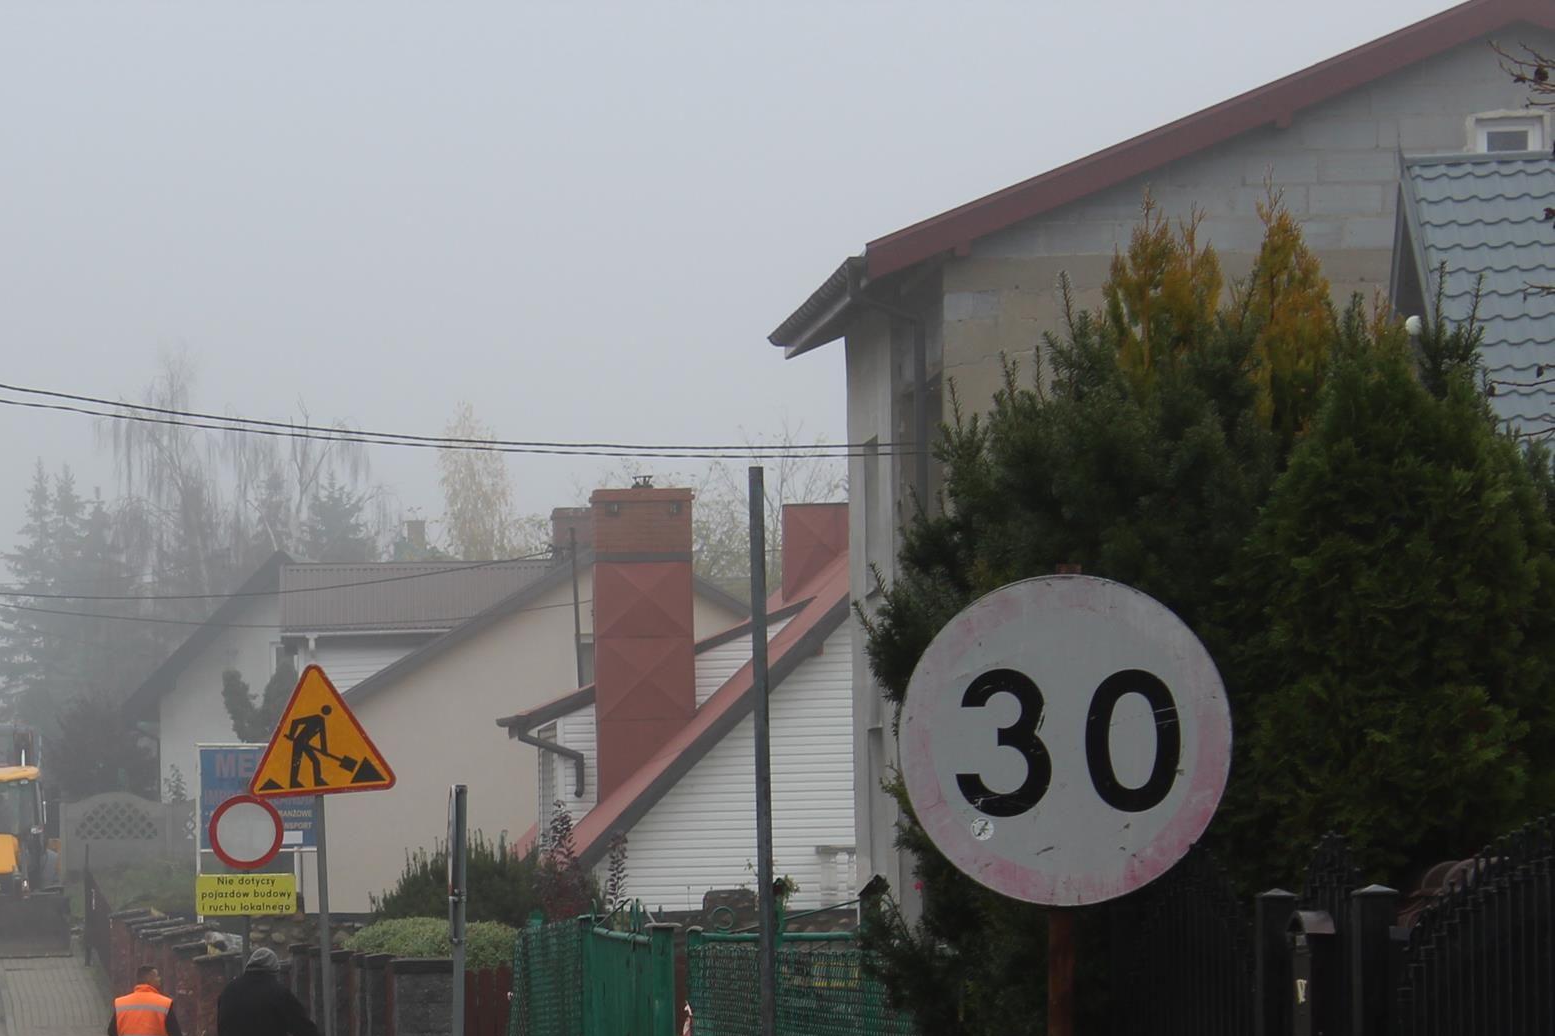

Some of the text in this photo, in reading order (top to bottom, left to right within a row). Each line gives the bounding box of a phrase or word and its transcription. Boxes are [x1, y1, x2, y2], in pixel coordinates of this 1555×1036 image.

[955, 668, 1181, 818] 30
[216, 754, 259, 778] ME
[217, 877, 276, 888] Nie dotyczy
[253, 889, 292, 900] budowy
[209, 903, 236, 912] ruchu
[240, 902, 291, 913] lokalnego
